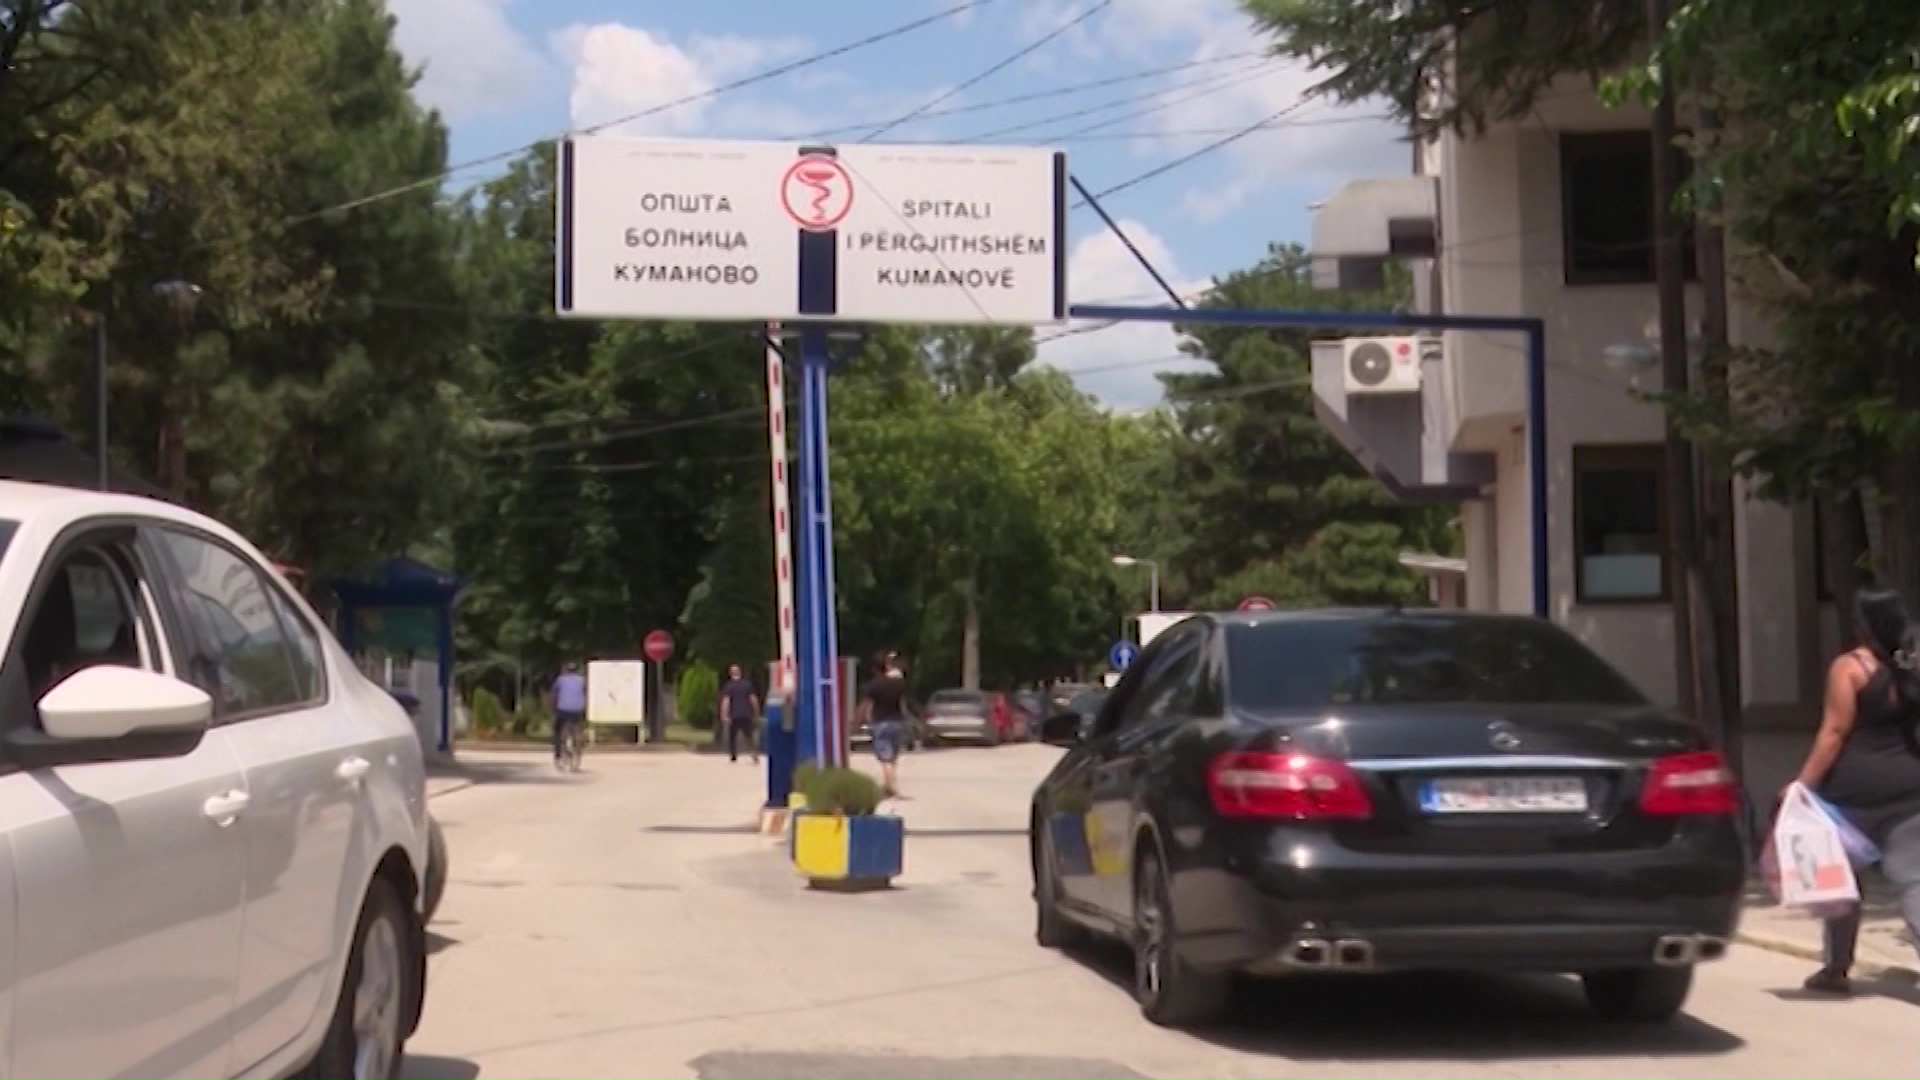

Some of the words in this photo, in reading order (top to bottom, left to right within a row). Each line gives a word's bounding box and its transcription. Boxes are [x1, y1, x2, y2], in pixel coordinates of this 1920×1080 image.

[641, 193, 732, 212] ОПШТА
[903, 200, 991, 219] SPITALI
[624, 228, 748, 251] БОЛНИЦА
[614, 264, 759, 285] КУМАНОВО
